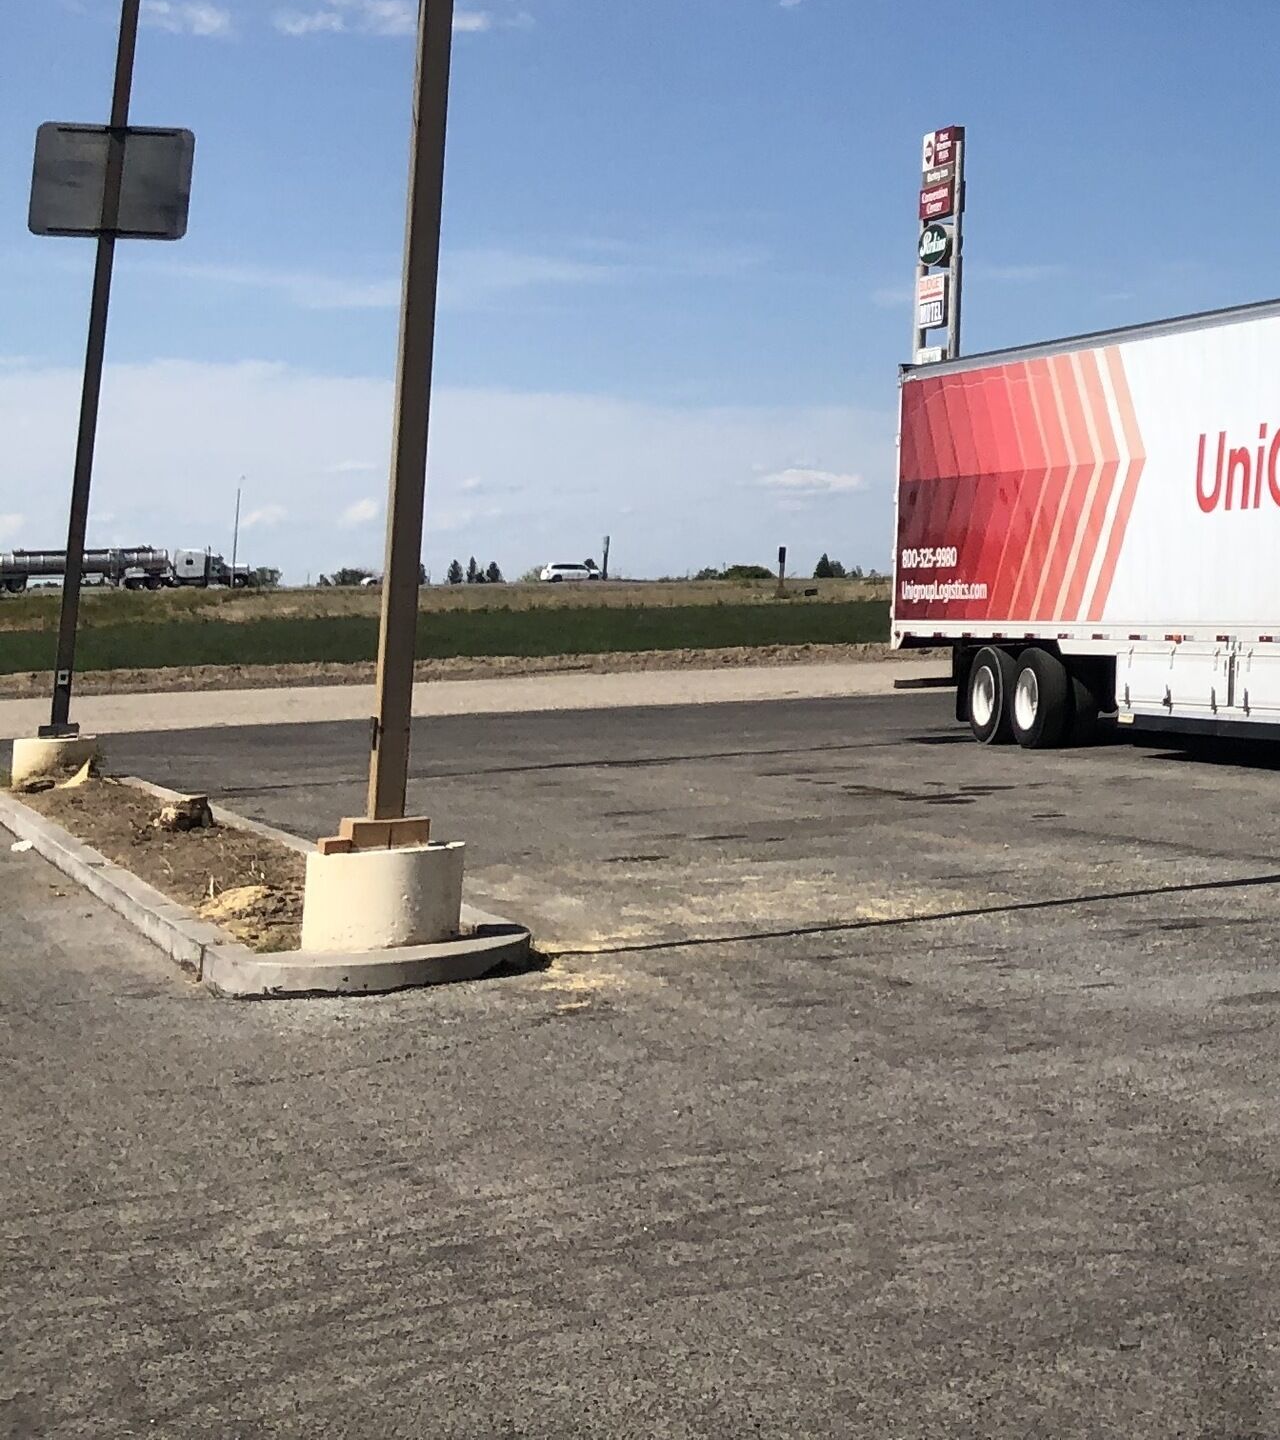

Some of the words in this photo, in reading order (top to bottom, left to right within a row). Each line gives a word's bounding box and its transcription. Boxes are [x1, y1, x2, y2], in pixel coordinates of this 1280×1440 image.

[919, 301, 943, 324] MOTEL
[901, 546, 958, 569] 800-325-9980
[901, 578, 988, 604] UnigroupLogistics.com
